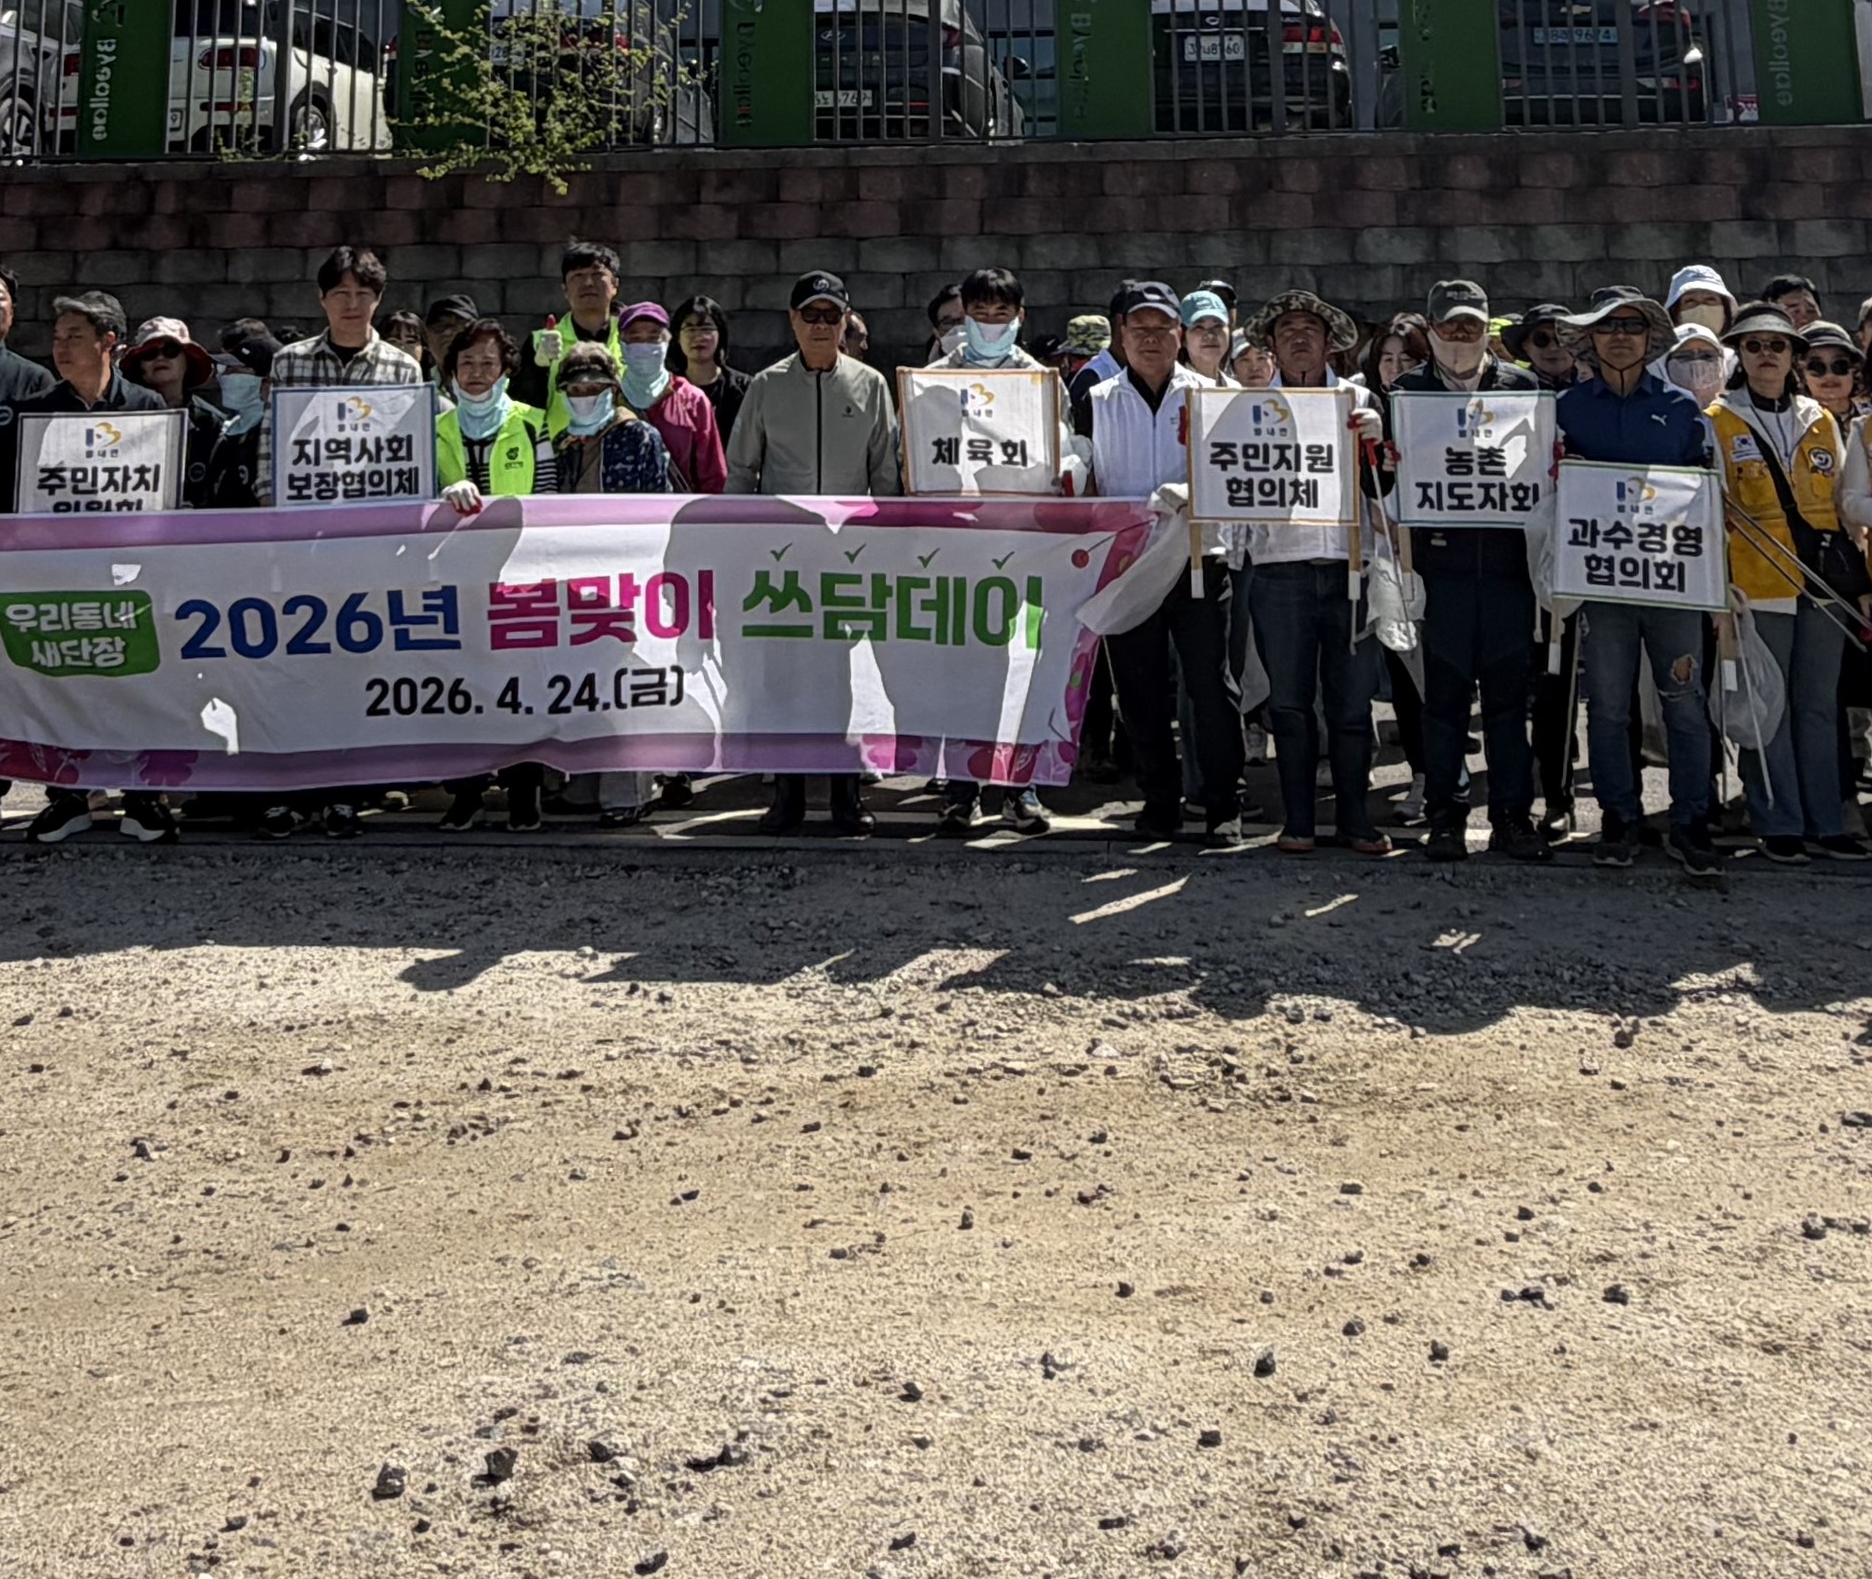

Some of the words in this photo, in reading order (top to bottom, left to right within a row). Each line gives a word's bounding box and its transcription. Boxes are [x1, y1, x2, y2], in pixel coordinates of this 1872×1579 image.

[291, 436, 414, 466] 지역사회
[932, 435, 1029, 468] 체육회
[1209, 442, 1333, 475] 주민지원
[1445, 446, 1507, 477] 농촌
[37, 464, 160, 498] 주민자치
[286, 466, 421, 502] 보장협의체
[1225, 476, 1319, 510] 협의체
[1415, 479, 1540, 514] 지도자회
[1568, 517, 1704, 556] 과수경영
[1584, 554, 1686, 595] 협의회
[5, 600, 137, 633] 우리동네
[174, 584, 461, 660] 2026년
[488, 570, 713, 651] 봄맞이
[742, 570, 1043, 650] 쓰담데이
[31, 636, 126, 669] 새단장
[365, 679, 484, 717] 2026.
